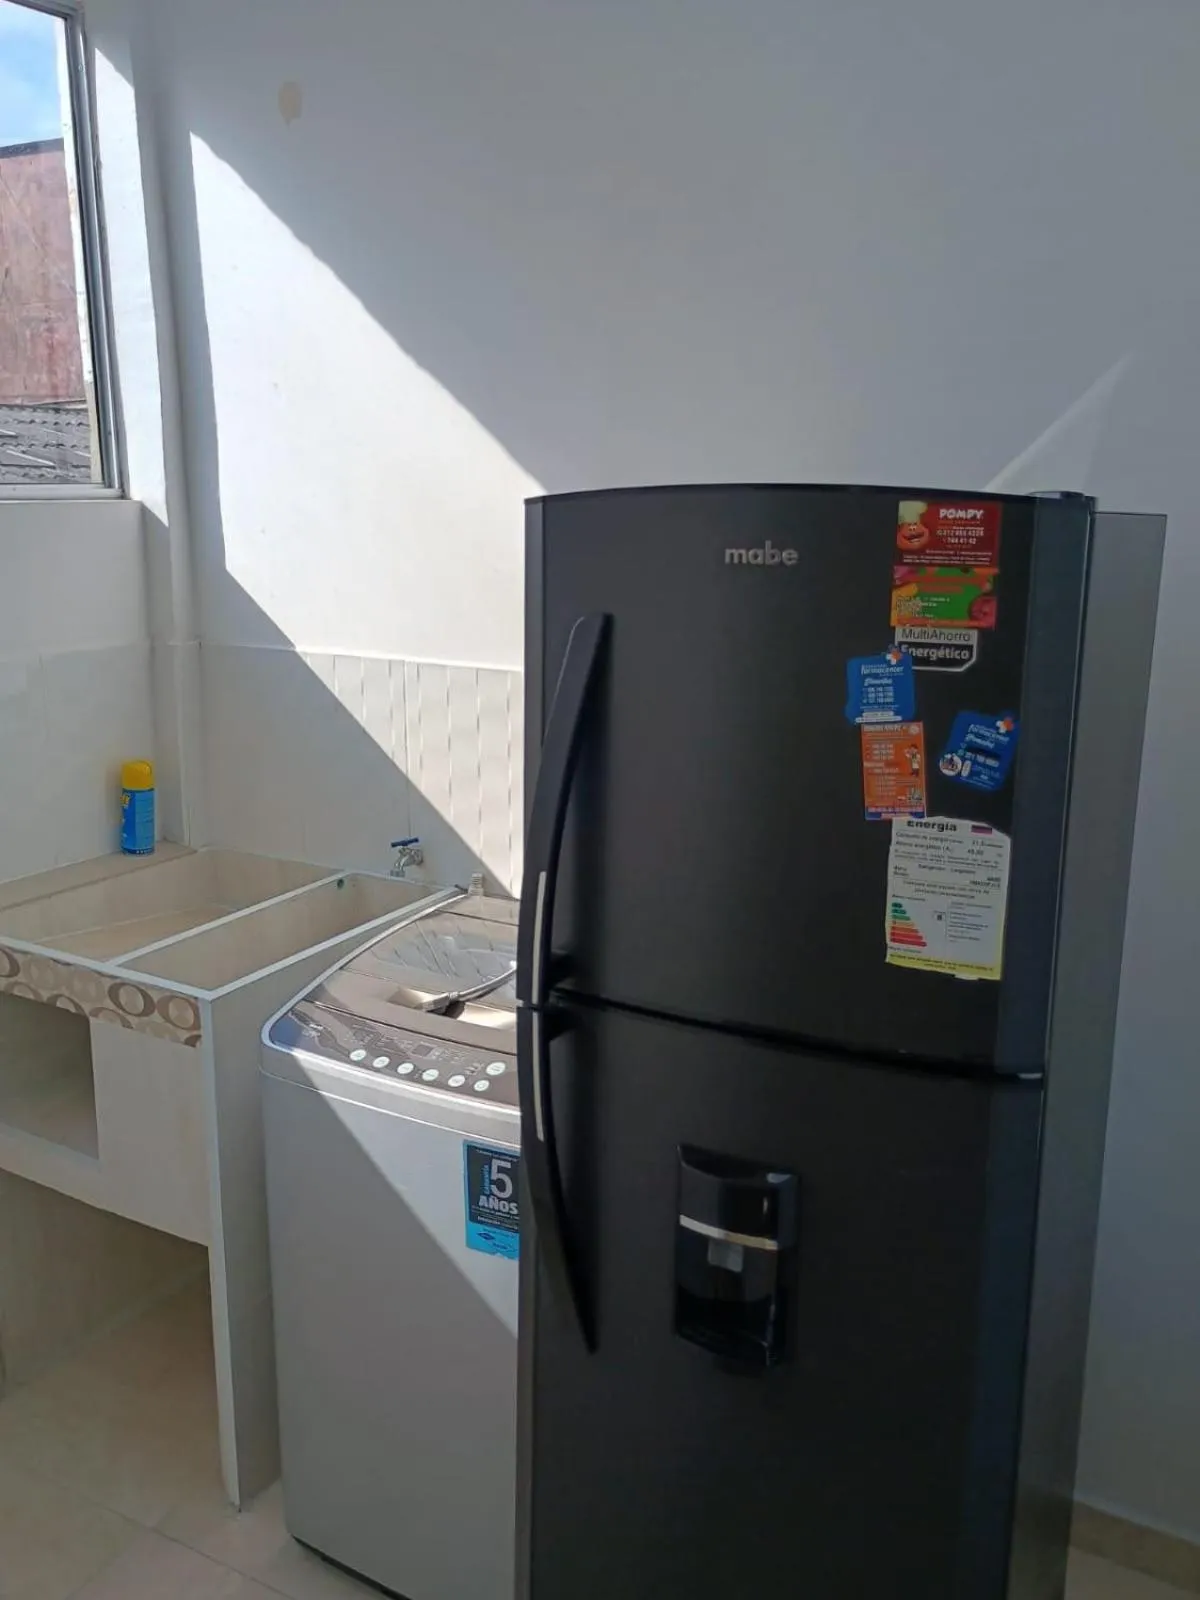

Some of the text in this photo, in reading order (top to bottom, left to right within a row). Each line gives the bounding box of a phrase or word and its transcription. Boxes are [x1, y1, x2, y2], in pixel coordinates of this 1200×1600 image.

[939, 508, 984, 520] POMPY
[725, 540, 798, 566] mabe
[901, 628, 971, 642] MultiAhorro
[901, 644, 969, 661] Energético
[491, 1158, 513, 1199] 5
[478, 1194, 519, 1215] AÑOS
